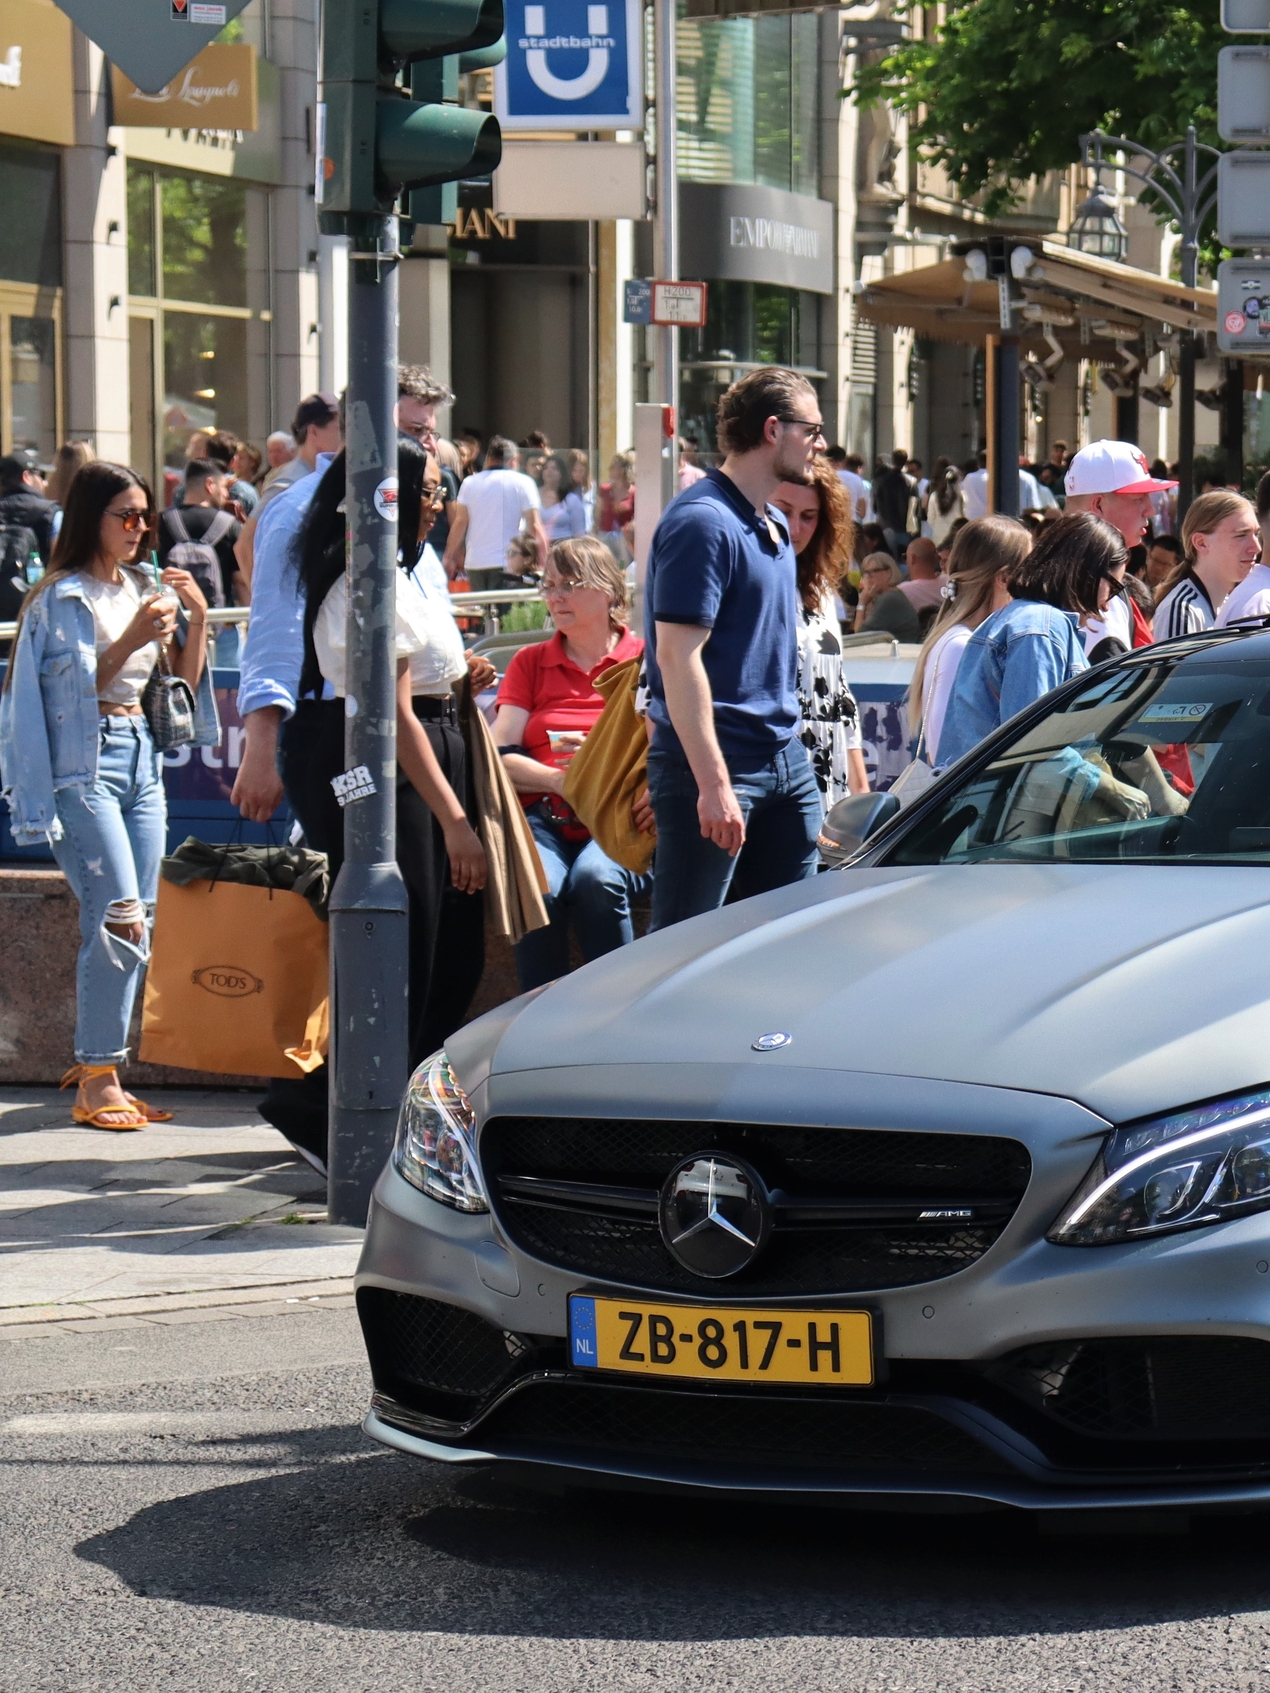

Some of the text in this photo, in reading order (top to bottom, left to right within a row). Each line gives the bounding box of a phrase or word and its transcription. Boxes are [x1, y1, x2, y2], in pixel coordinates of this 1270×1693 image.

[518, 35, 616, 49] stadtbahn
[663, 286, 692, 297] H200
[330, 765, 374, 797] KSR
[336, 783, 378, 807] 9 JAHRE
[936, 1209, 972, 1218] AMG
[576, 1338, 594, 1355] NL
[618, 1311, 841, 1373] ZB-817-H
